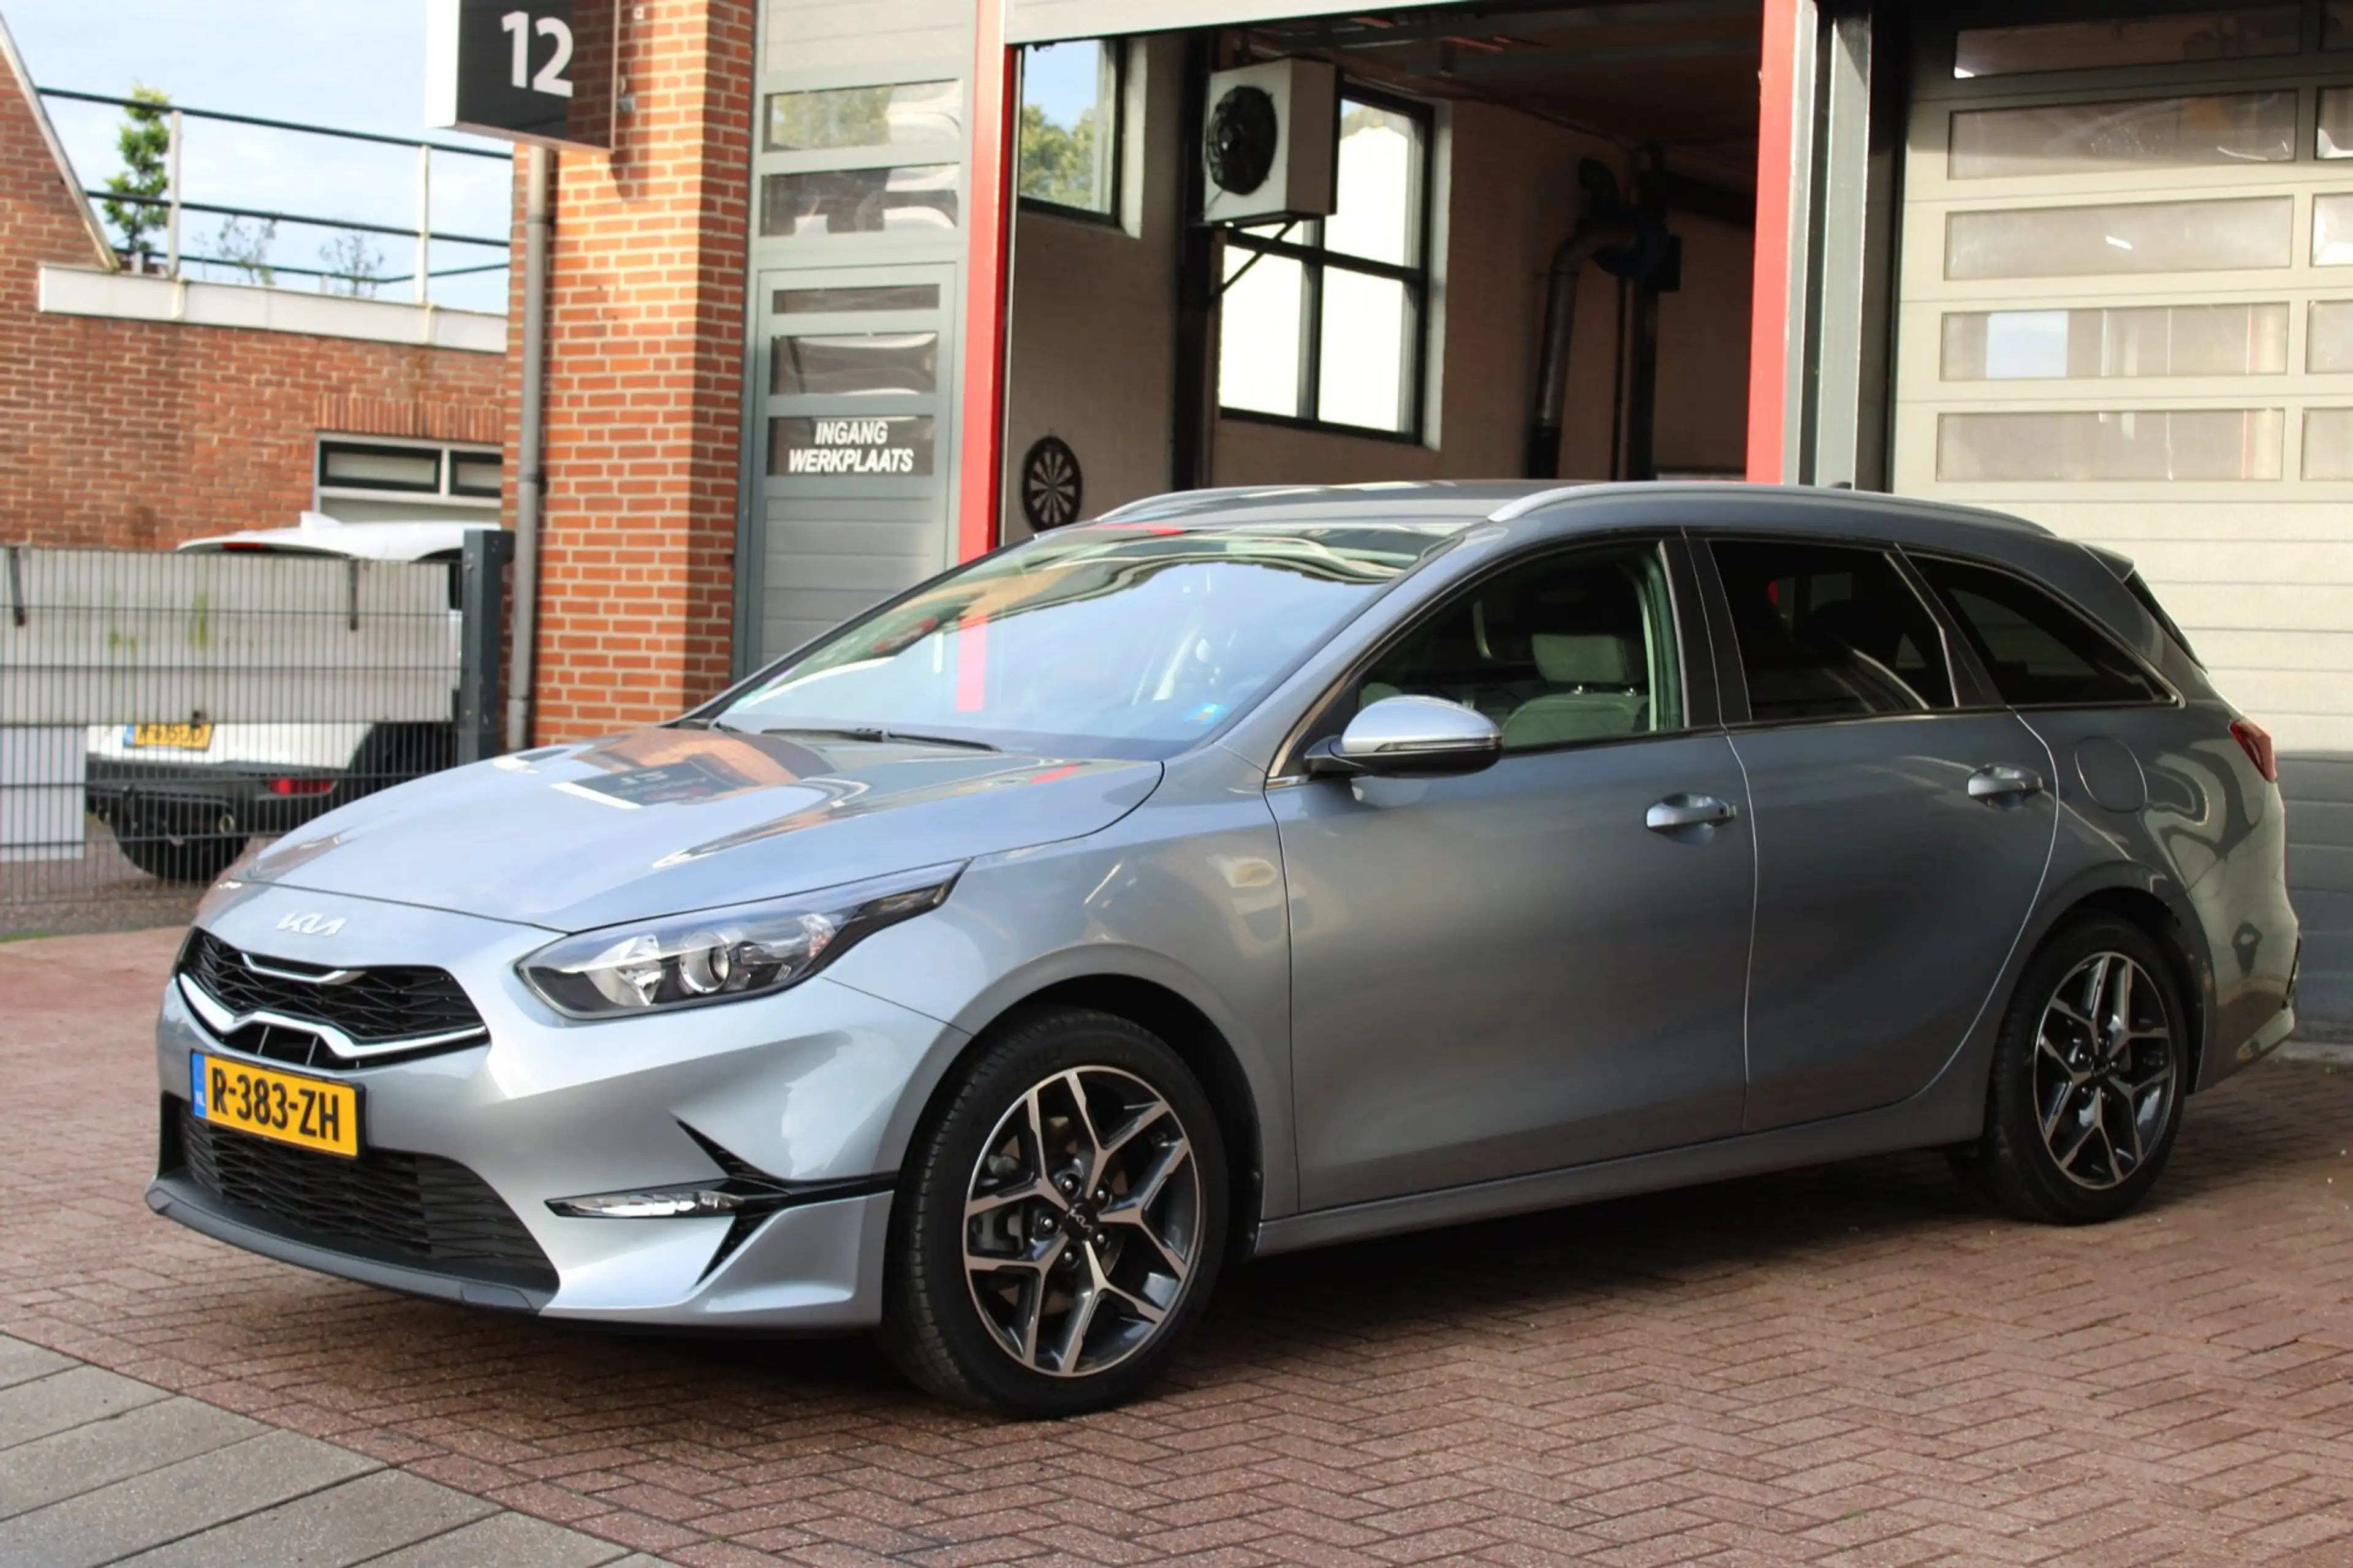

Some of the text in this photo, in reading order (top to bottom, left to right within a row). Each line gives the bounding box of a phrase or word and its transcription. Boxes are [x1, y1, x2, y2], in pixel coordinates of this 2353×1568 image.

[501, 10, 574, 98] 12
[814, 420, 888, 445] INGANG
[789, 447, 914, 472] WERKPLAATS
[276, 911, 347, 936] KIA
[195, 1090, 206, 1107] NL
[212, 1067, 339, 1142] R-383-ZH
